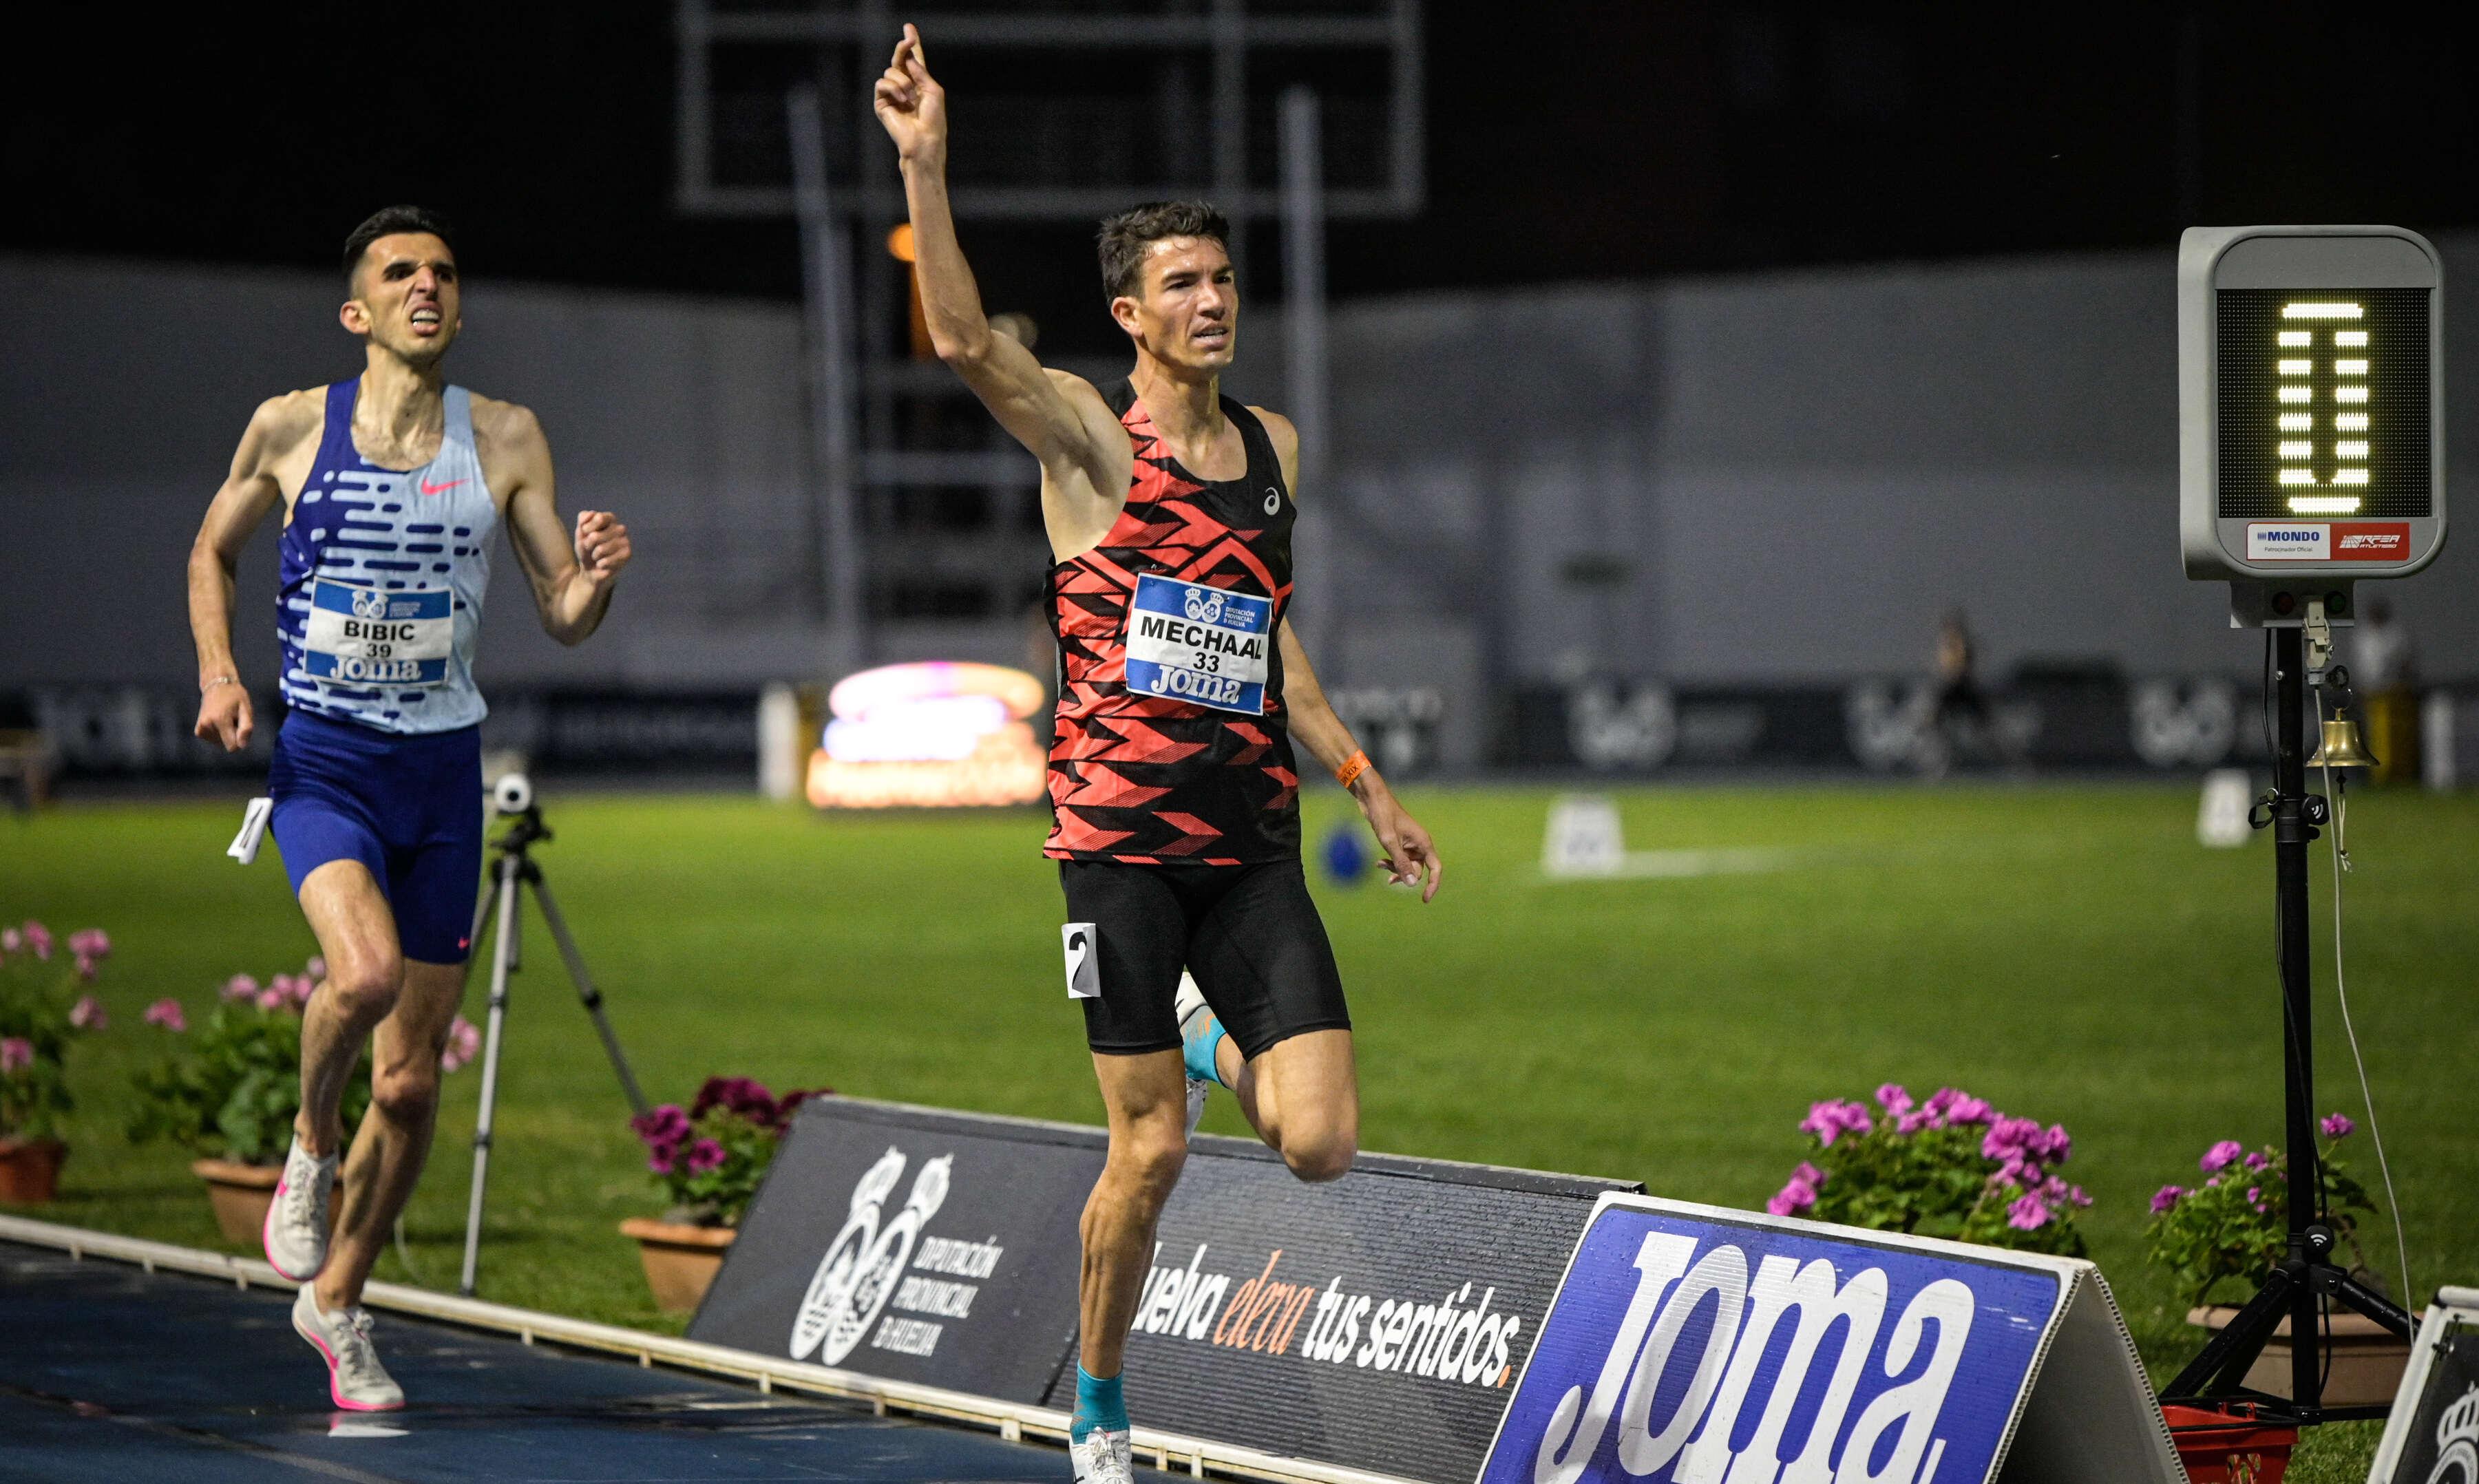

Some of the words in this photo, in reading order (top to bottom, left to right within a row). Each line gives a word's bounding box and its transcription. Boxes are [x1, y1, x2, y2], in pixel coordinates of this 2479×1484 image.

[2278, 303, 2368, 513] 0
[2268, 531, 2320, 541] MONDO
[1224, 612, 1254, 624] PROVINCIAL
[1227, 619, 1245, 628] HUELVA
[344, 621, 415, 641] BIBIC
[1140, 615, 1262, 659] MECHAAL
[366, 644, 392, 658] 39
[1192, 652, 1220, 672] 33
[330, 656, 422, 681] Joma
[1150, 664, 1242, 705] Joma
[892, 1275, 979, 1319] PROVINCIAL
[1131, 1240, 1231, 1341] uelva
[1301, 1275, 1371, 1364] tus
[1356, 1281, 1520, 1388] sentidos.
[1534, 1231, 1975, 1484] Joma
